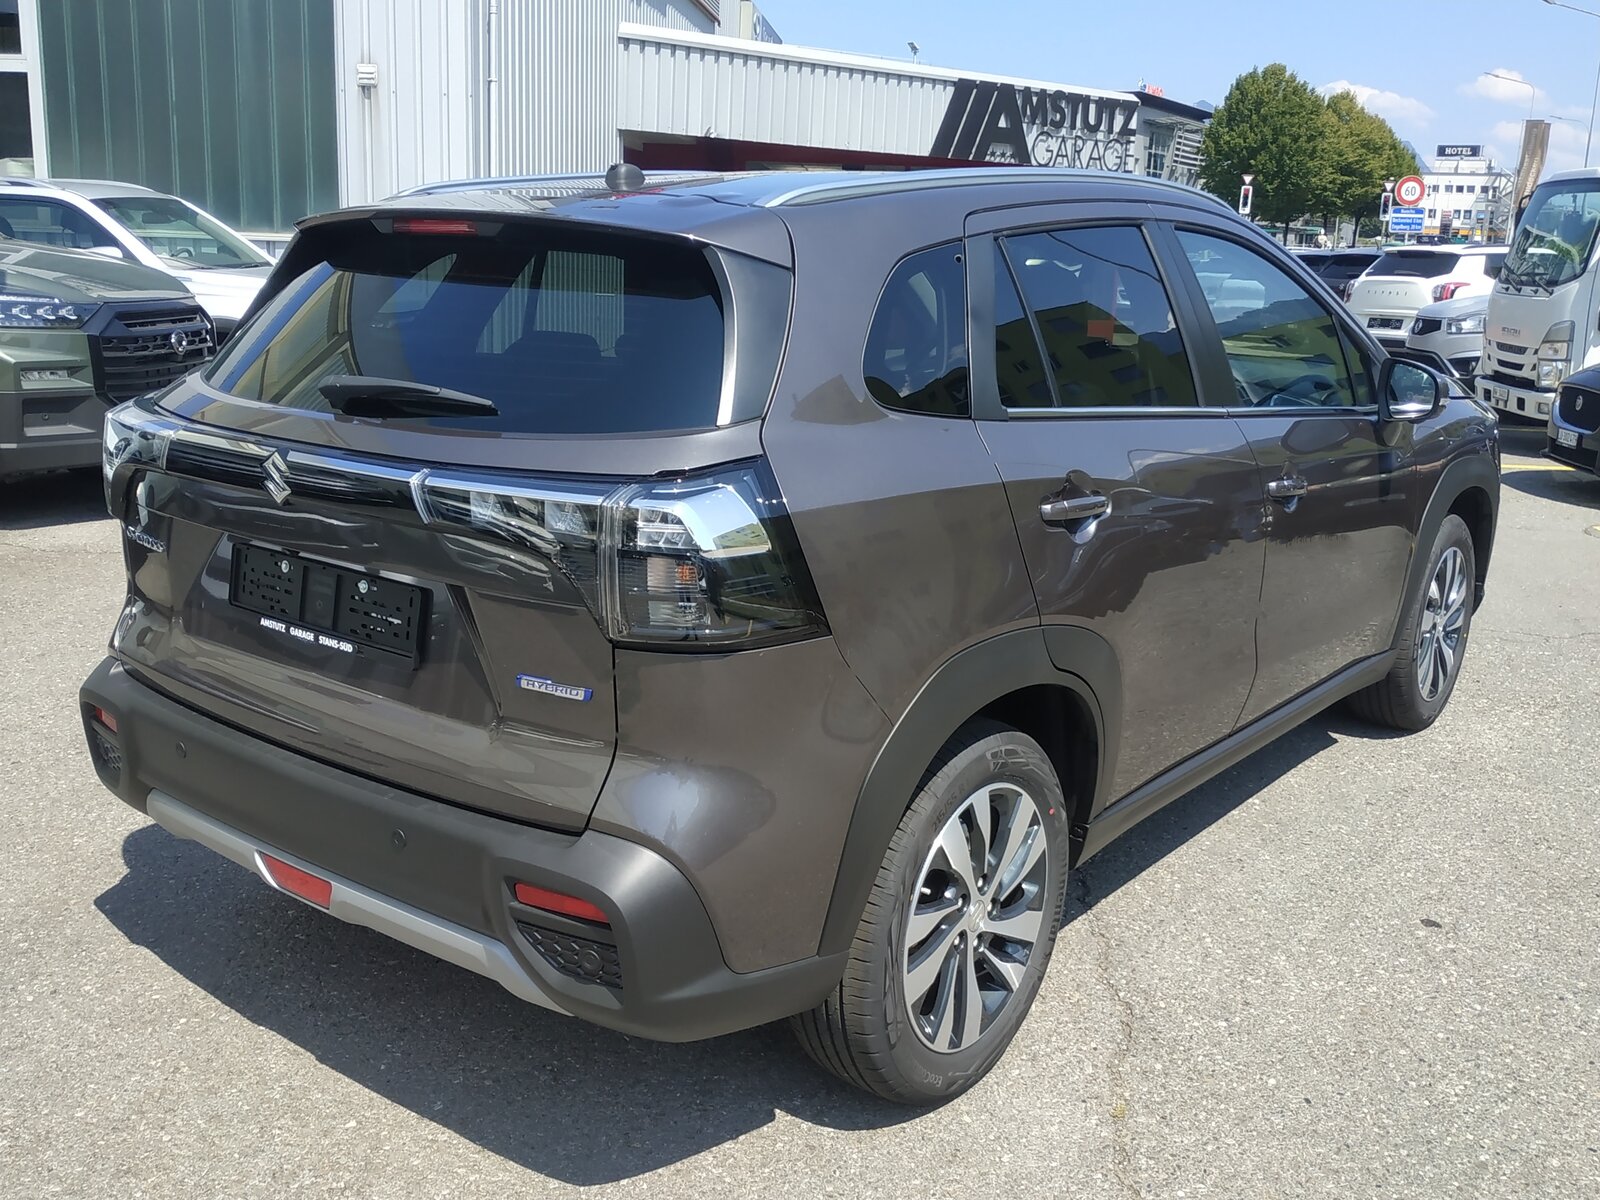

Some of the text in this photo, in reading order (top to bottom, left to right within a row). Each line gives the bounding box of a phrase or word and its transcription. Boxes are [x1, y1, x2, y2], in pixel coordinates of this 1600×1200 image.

[970, 83, 1140, 164] AMSTUTZ
[1032, 131, 1136, 173] GARAGE
[1445, 147, 1473, 155] HOTEL
[1404, 185, 1416, 196] 60
[260, 617, 286, 633] AMSTUTZ
[289, 626, 315, 642] GARAGE
[526, 680, 579, 697] HYBRID
